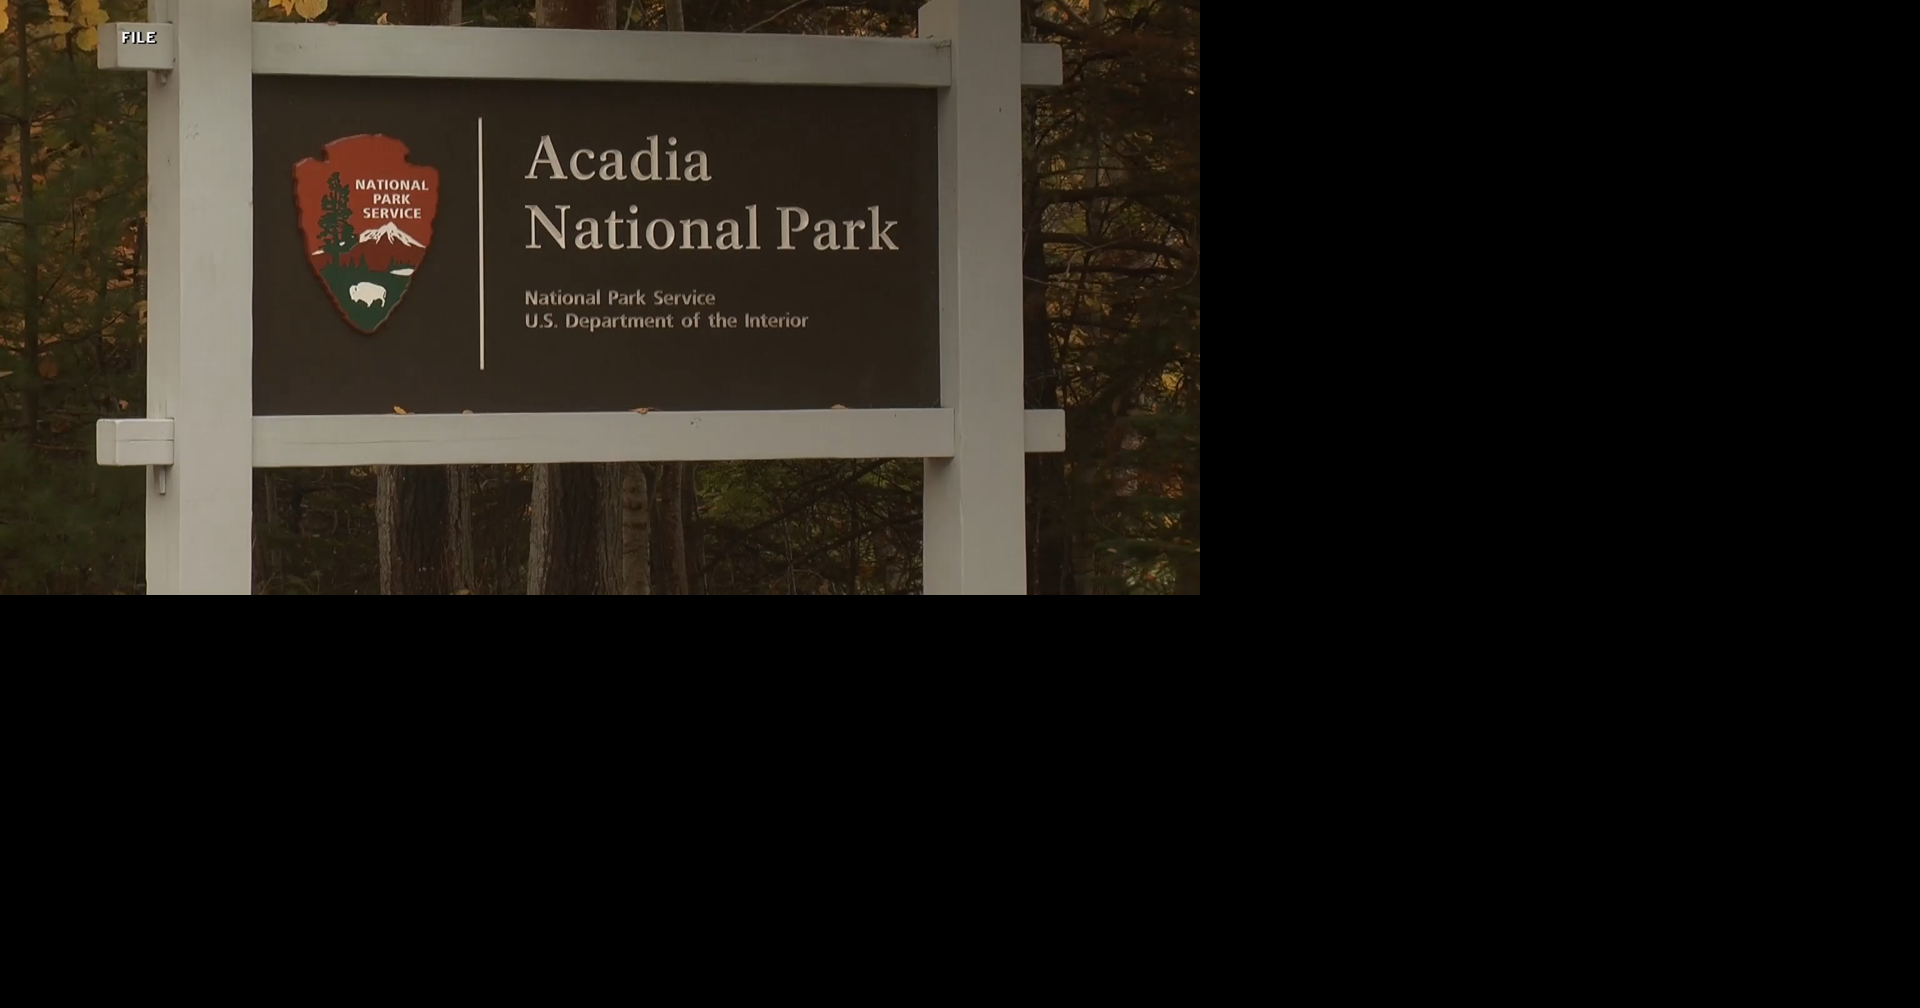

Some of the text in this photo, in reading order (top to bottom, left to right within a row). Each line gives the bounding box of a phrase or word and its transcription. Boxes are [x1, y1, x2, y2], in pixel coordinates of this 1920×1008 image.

[524, 134, 713, 182] Acadia
[355, 179, 429, 191] NATIONAL
[373, 193, 411, 205] PARK
[362, 207, 422, 219] SERVICE
[524, 204, 900, 251] National Park
[525, 289, 716, 306] National Park Service
[525, 311, 809, 333] U.S. Department of the Interior
